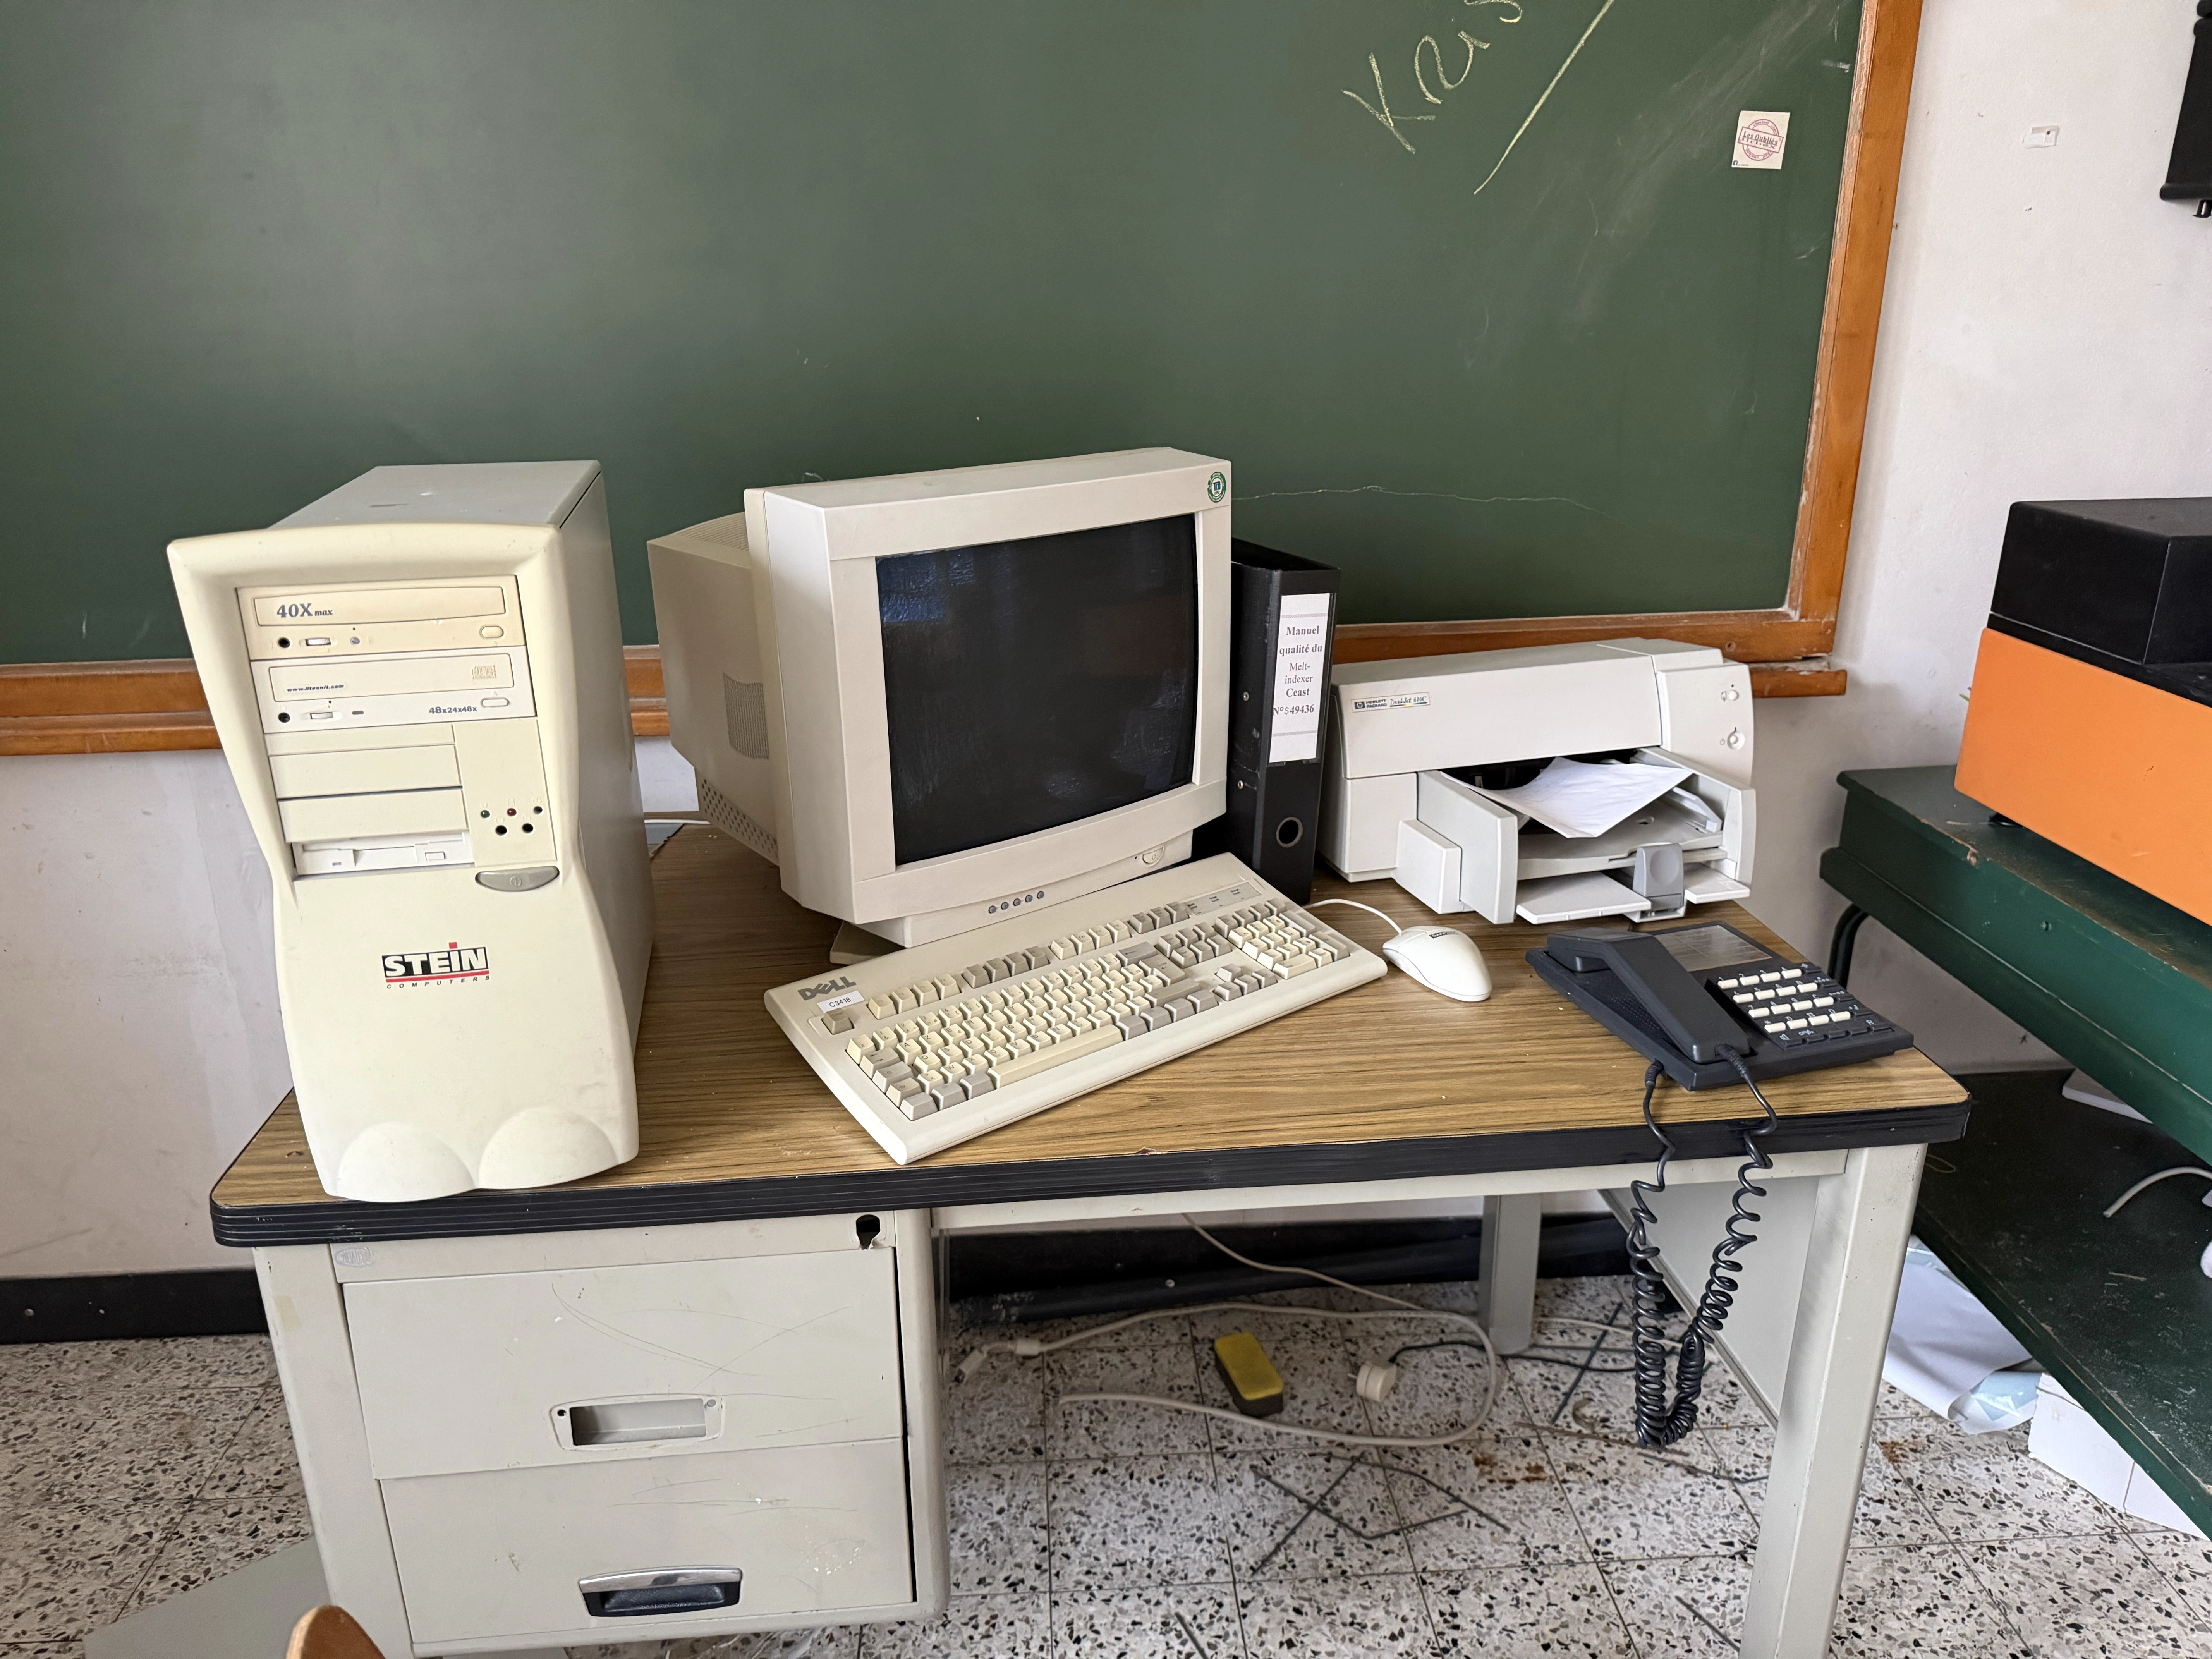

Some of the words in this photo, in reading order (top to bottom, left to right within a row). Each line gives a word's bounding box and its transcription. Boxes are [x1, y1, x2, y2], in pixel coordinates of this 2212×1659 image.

[277, 603, 313, 618] 40X
[1286, 625, 1319, 635] Manuel
[1279, 644, 1309, 657] qualité
[1312, 644, 1322, 652] du
[1289, 662, 1310, 671] Melt-
[1285, 675, 1313, 684] indexer
[1286, 688, 1310, 697] Ceast
[429, 706, 477, 714] 48x24x48x
[386, 975, 490, 989] COMPUTERS
[798, 976, 857, 1001] DELL
[829, 997, 851, 1007] C3418
